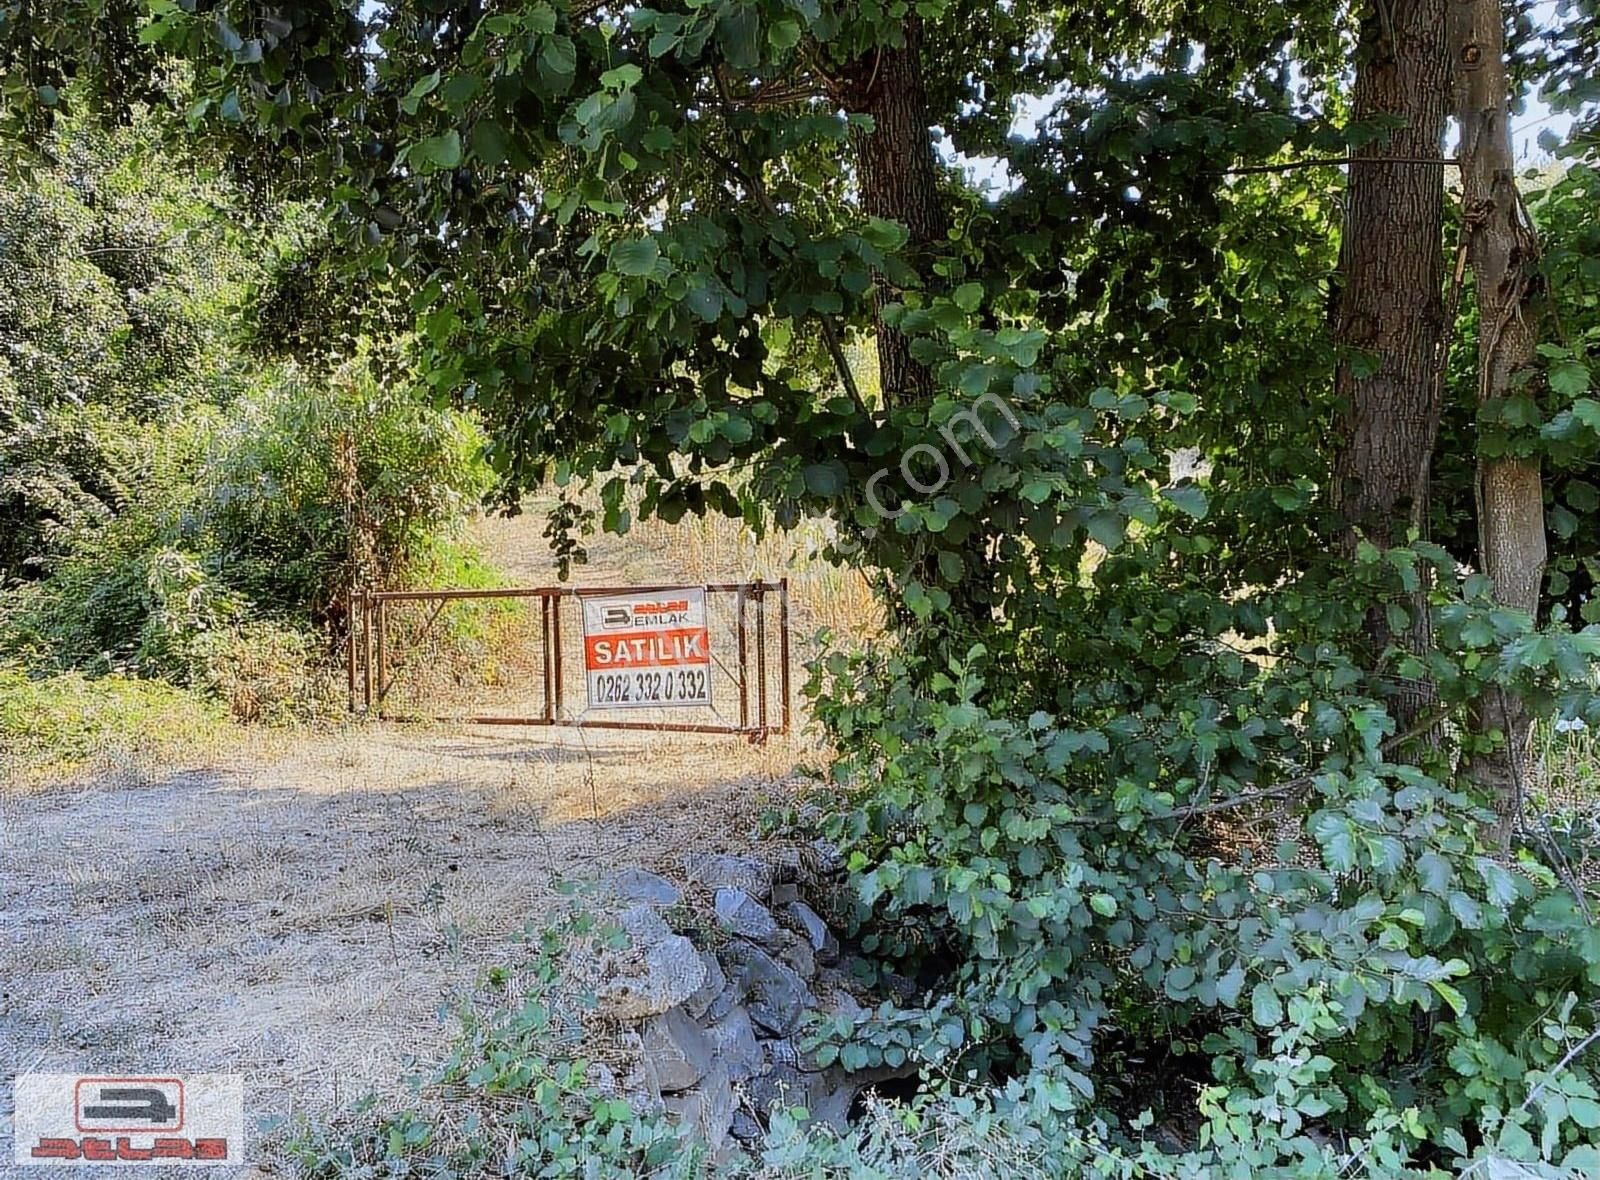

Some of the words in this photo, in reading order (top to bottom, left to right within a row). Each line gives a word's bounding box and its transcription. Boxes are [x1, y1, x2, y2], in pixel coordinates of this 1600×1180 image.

[634, 612, 689, 626] EMLAK
[594, 634, 702, 664] SATILIK
[597, 674, 630, 702] 0262
[635, 672, 661, 701] 332
[665, 671, 674, 700] 0
[678, 670, 706, 699] 332
